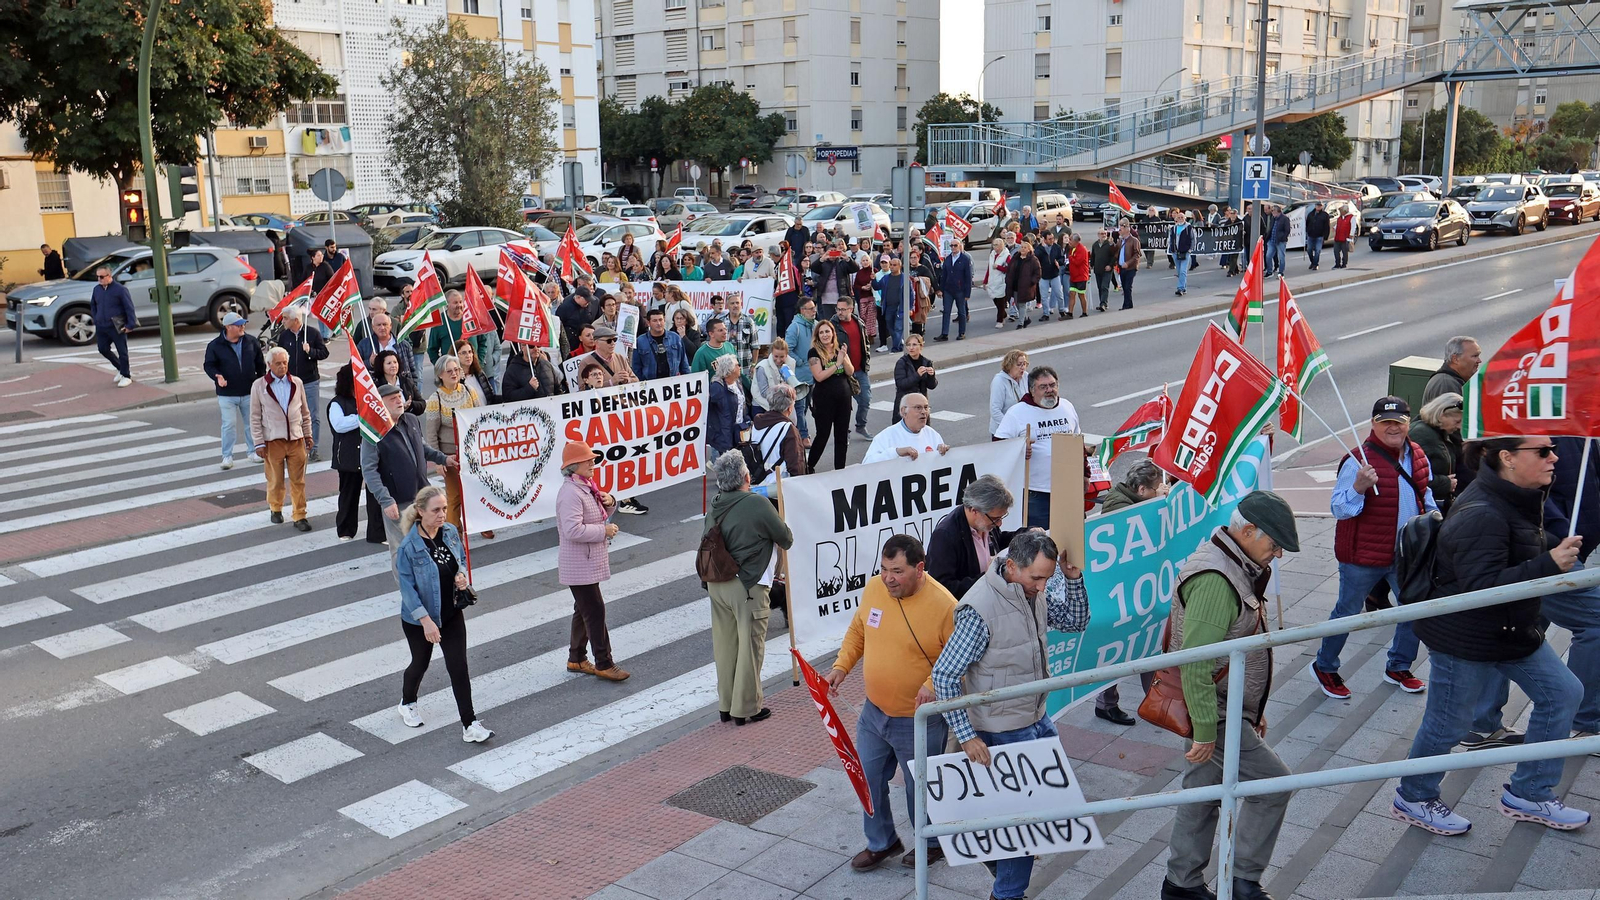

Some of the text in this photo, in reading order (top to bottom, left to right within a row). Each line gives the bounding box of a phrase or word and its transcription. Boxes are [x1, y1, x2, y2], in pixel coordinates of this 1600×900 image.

[562, 379, 703, 420] EN DEFENSA DE LA
[1502, 352, 1539, 420] Cádiz
[363, 393, 390, 422] Cádiz
[1384, 403, 1398, 411] CAT
[564, 397, 702, 448] SANIDAD
[1037, 417, 1069, 429] MAREA
[479, 424, 539, 449] MAREA
[653, 426, 701, 450] 100
[481, 442, 539, 465] BLANCA
[485, 502, 506, 518] PUERTO
[514, 503, 531, 519] SANTA
[530, 483, 543, 504] MARÍA
[831, 462, 978, 533] MAREA
[818, 598, 859, 617] MEDI
[1047, 637, 1077, 658] eas
[926, 748, 1070, 802] PÚBLICA
